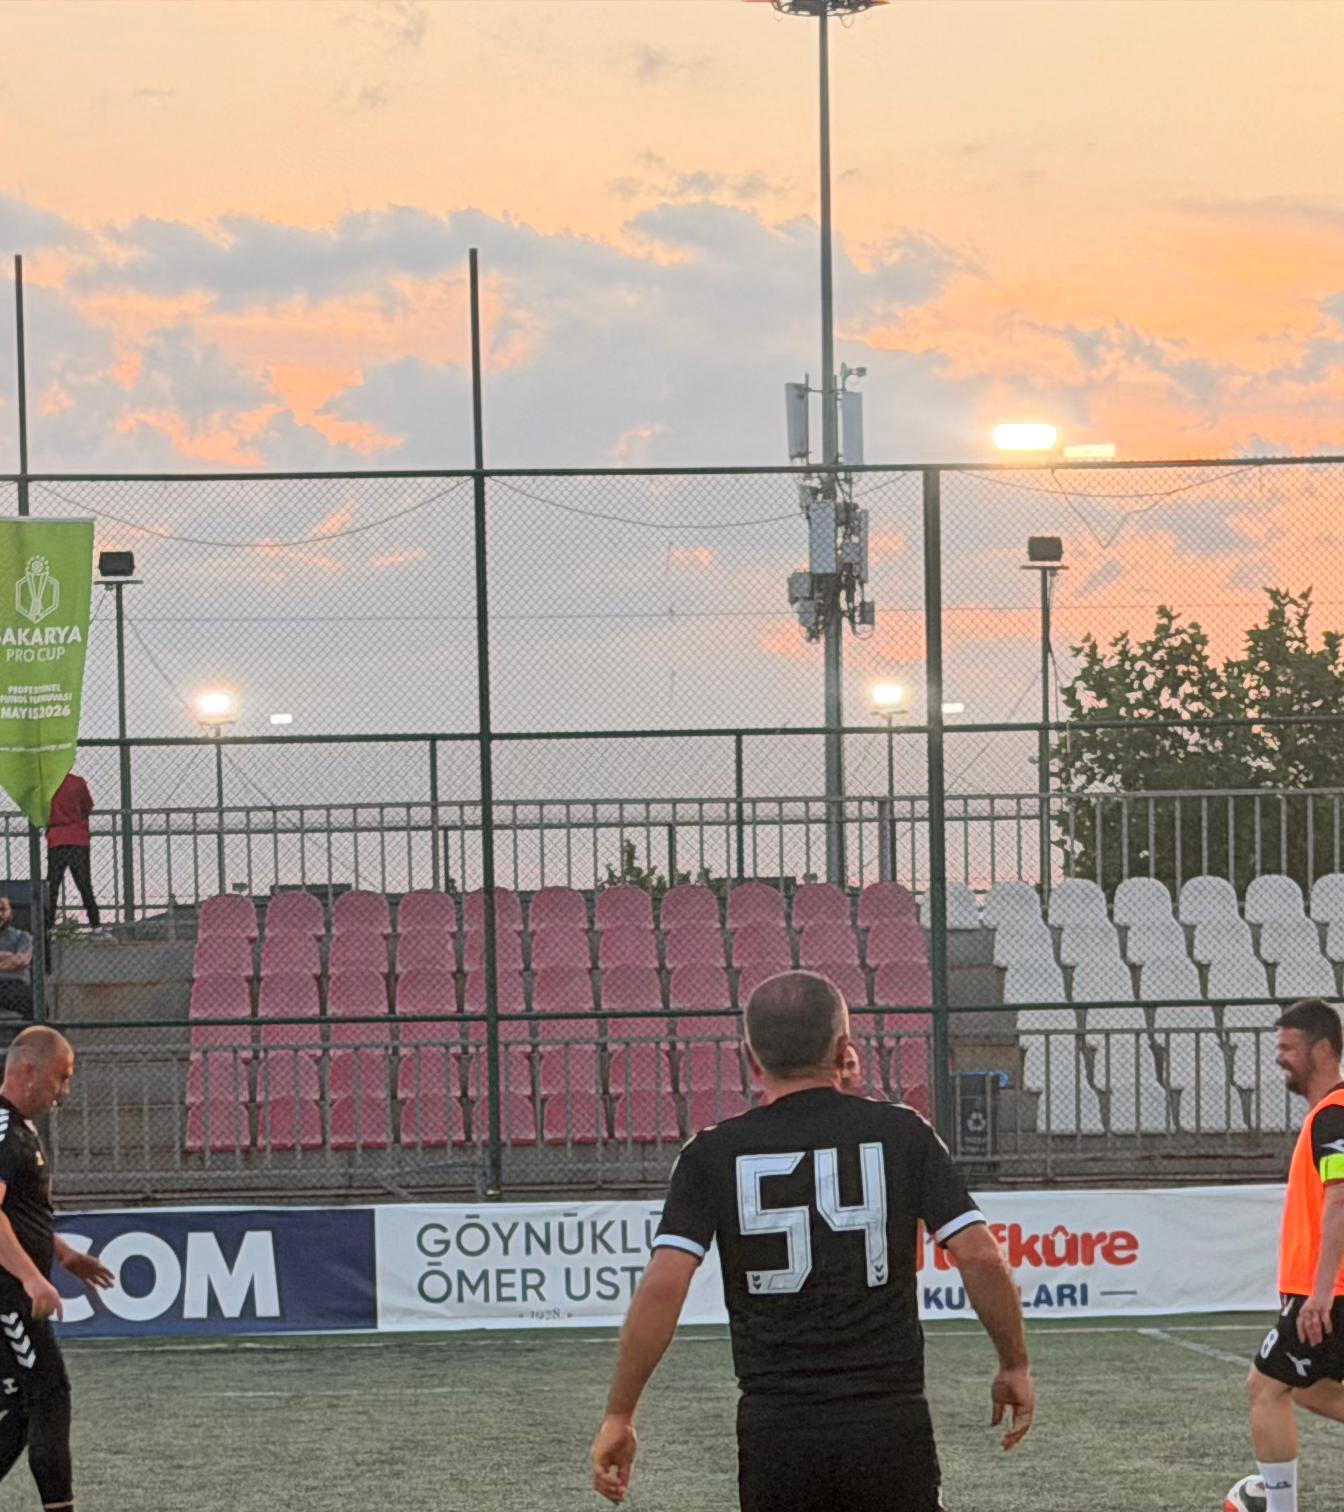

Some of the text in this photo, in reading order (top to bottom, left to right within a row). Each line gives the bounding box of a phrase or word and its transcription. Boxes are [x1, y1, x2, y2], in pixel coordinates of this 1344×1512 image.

[7, 647, 65, 663] PRO CUP
[38, 705, 71, 719] 2026
[736, 1141, 888, 1294] 54
[564, 1266, 644, 1302] UST
[924, 1283, 1089, 1310] KUARI
[529, 1309, 561, 1321] 1978
[1260, 1328, 1279, 1359] 8
